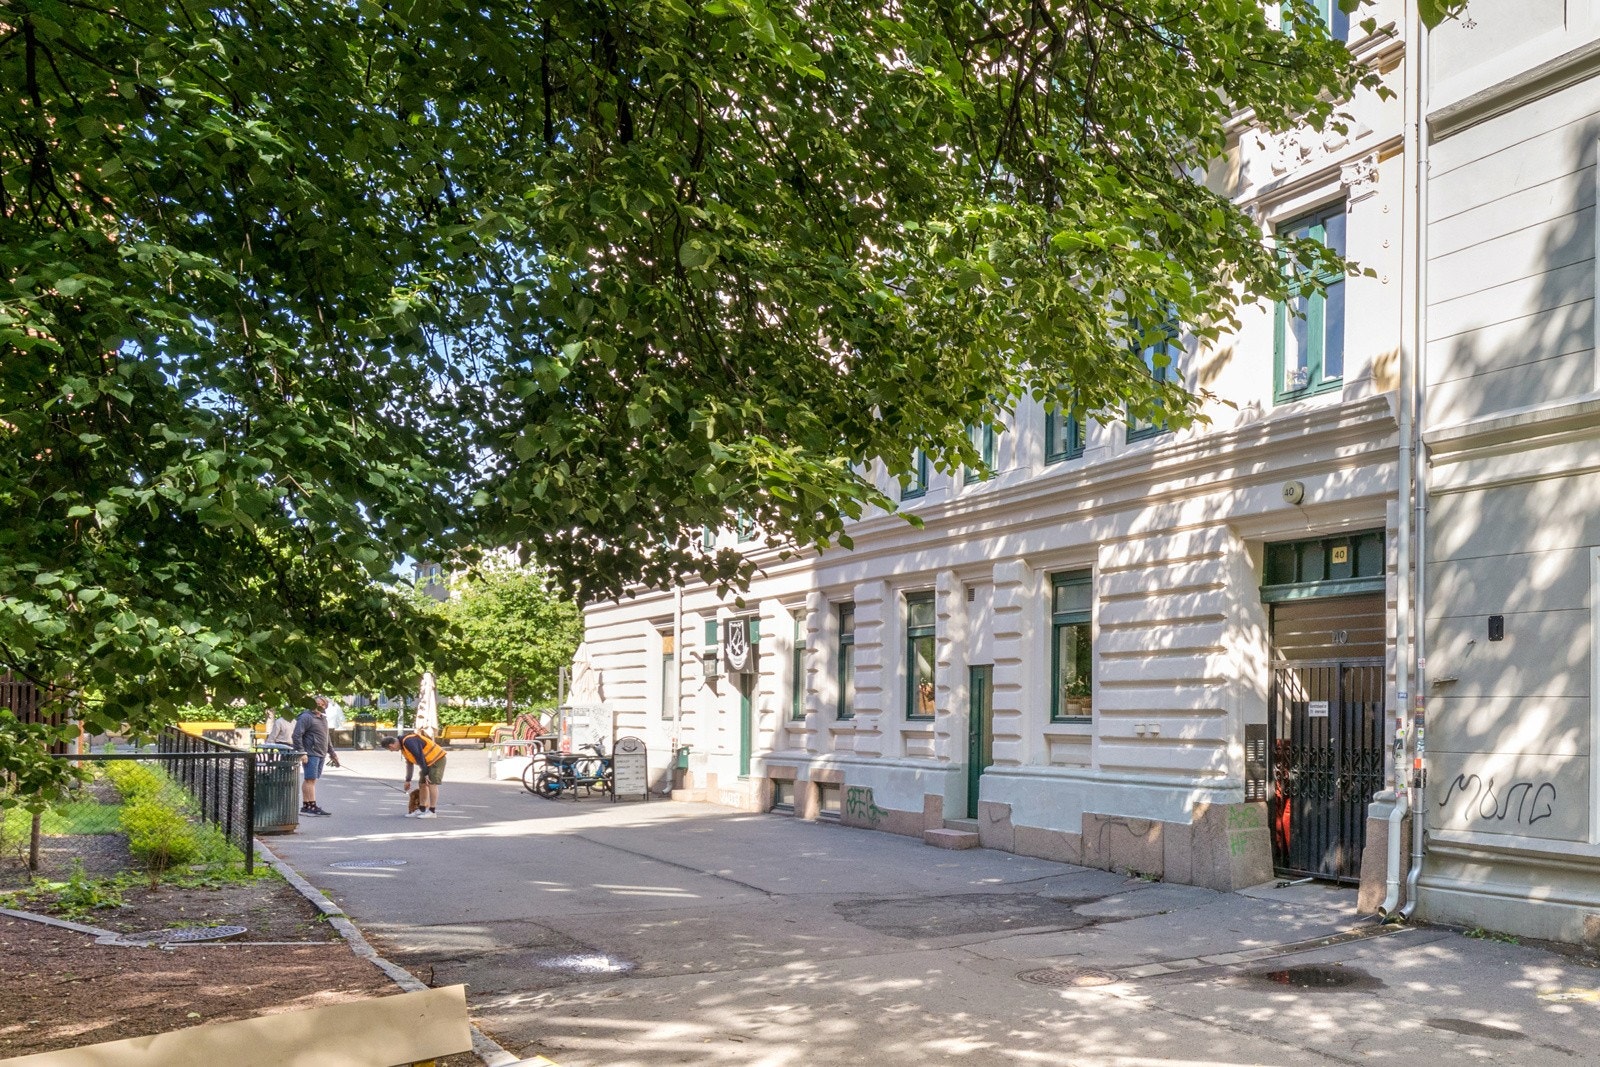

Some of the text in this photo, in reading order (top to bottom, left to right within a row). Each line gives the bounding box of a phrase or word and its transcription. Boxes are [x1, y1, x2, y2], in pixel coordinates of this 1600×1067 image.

[1284, 487, 1295, 496] 40
[1334, 550, 1345, 559] 40
[1331, 630, 1348, 644] 40
